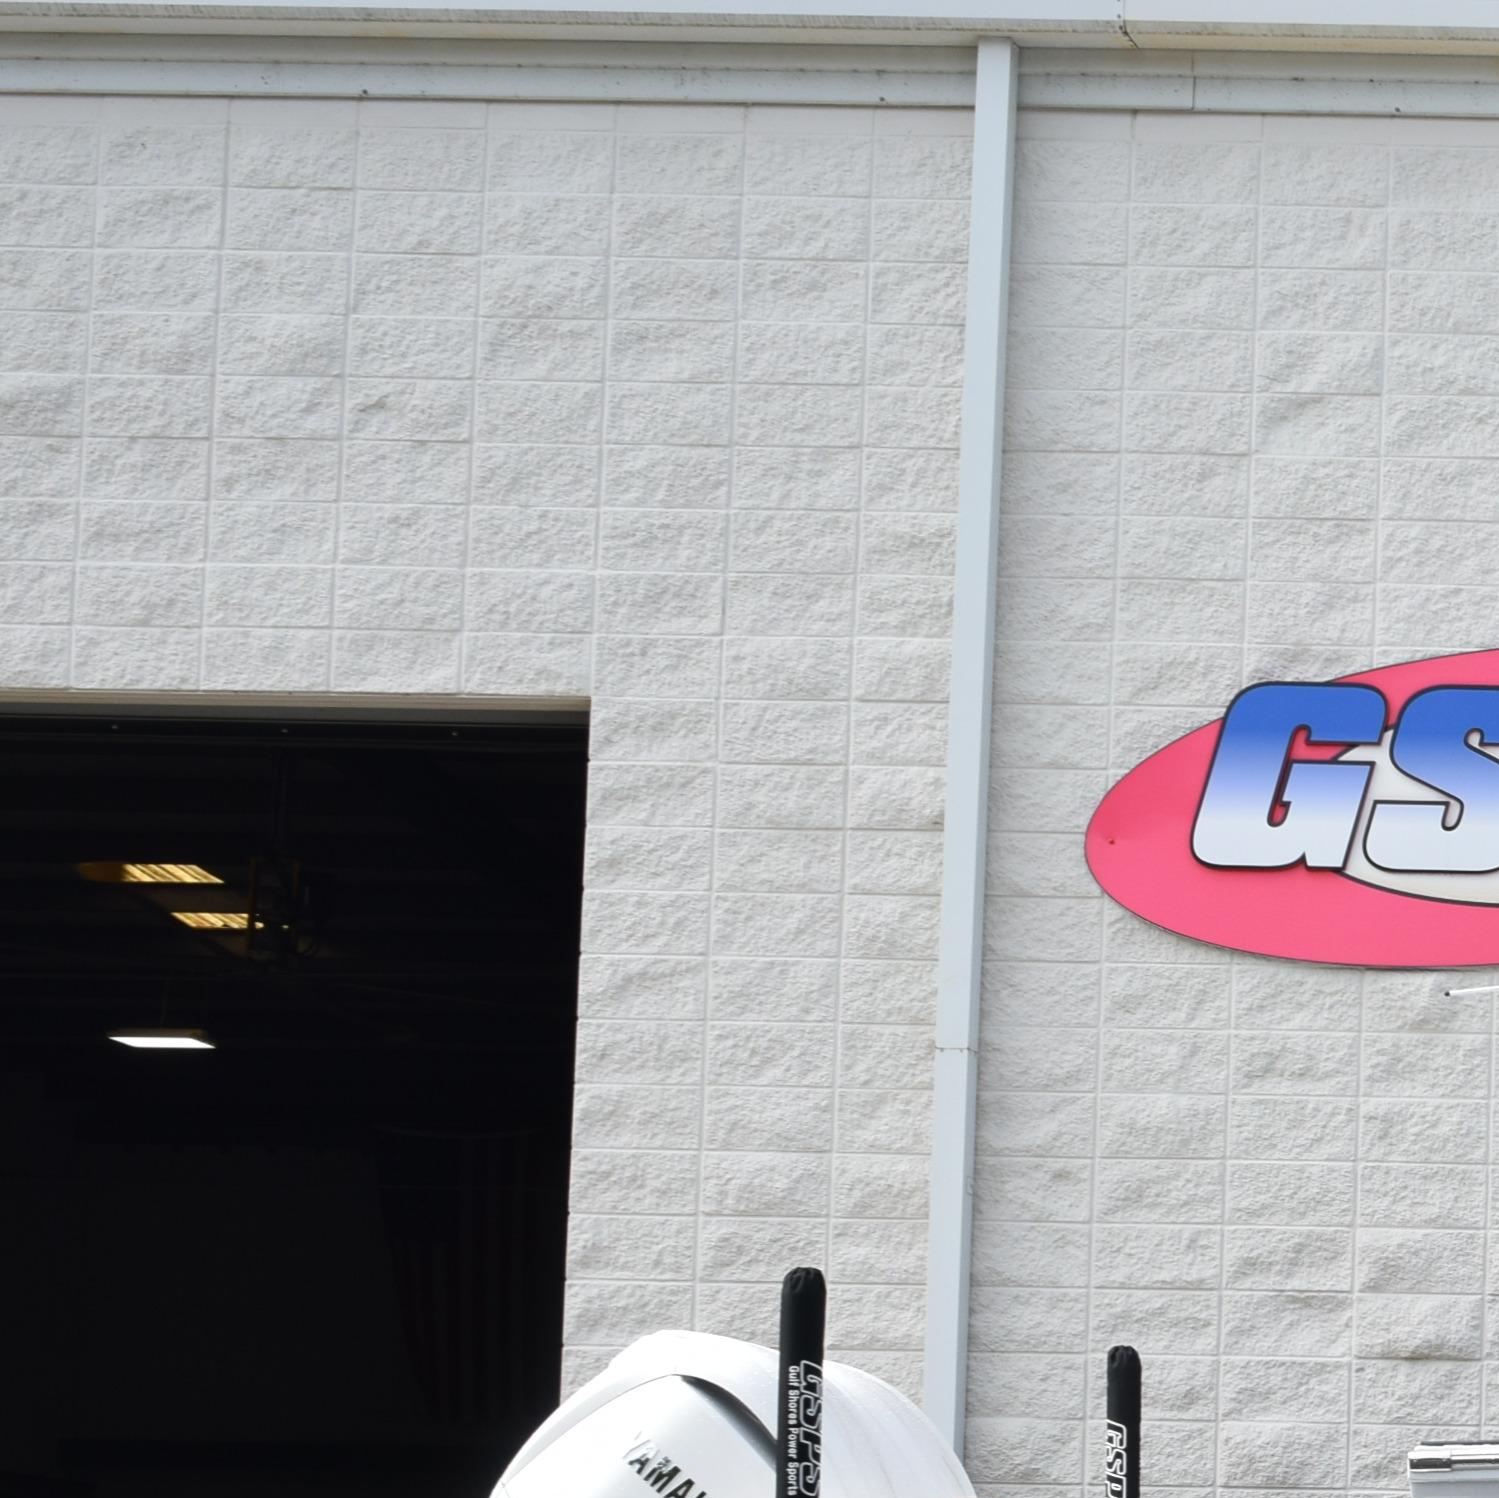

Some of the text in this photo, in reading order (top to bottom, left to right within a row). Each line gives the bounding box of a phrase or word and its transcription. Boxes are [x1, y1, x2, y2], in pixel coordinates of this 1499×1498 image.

[786, 1365, 800, 1496] Gulf Shores Power Sports
[800, 1360, 822, 1497] GSPS
